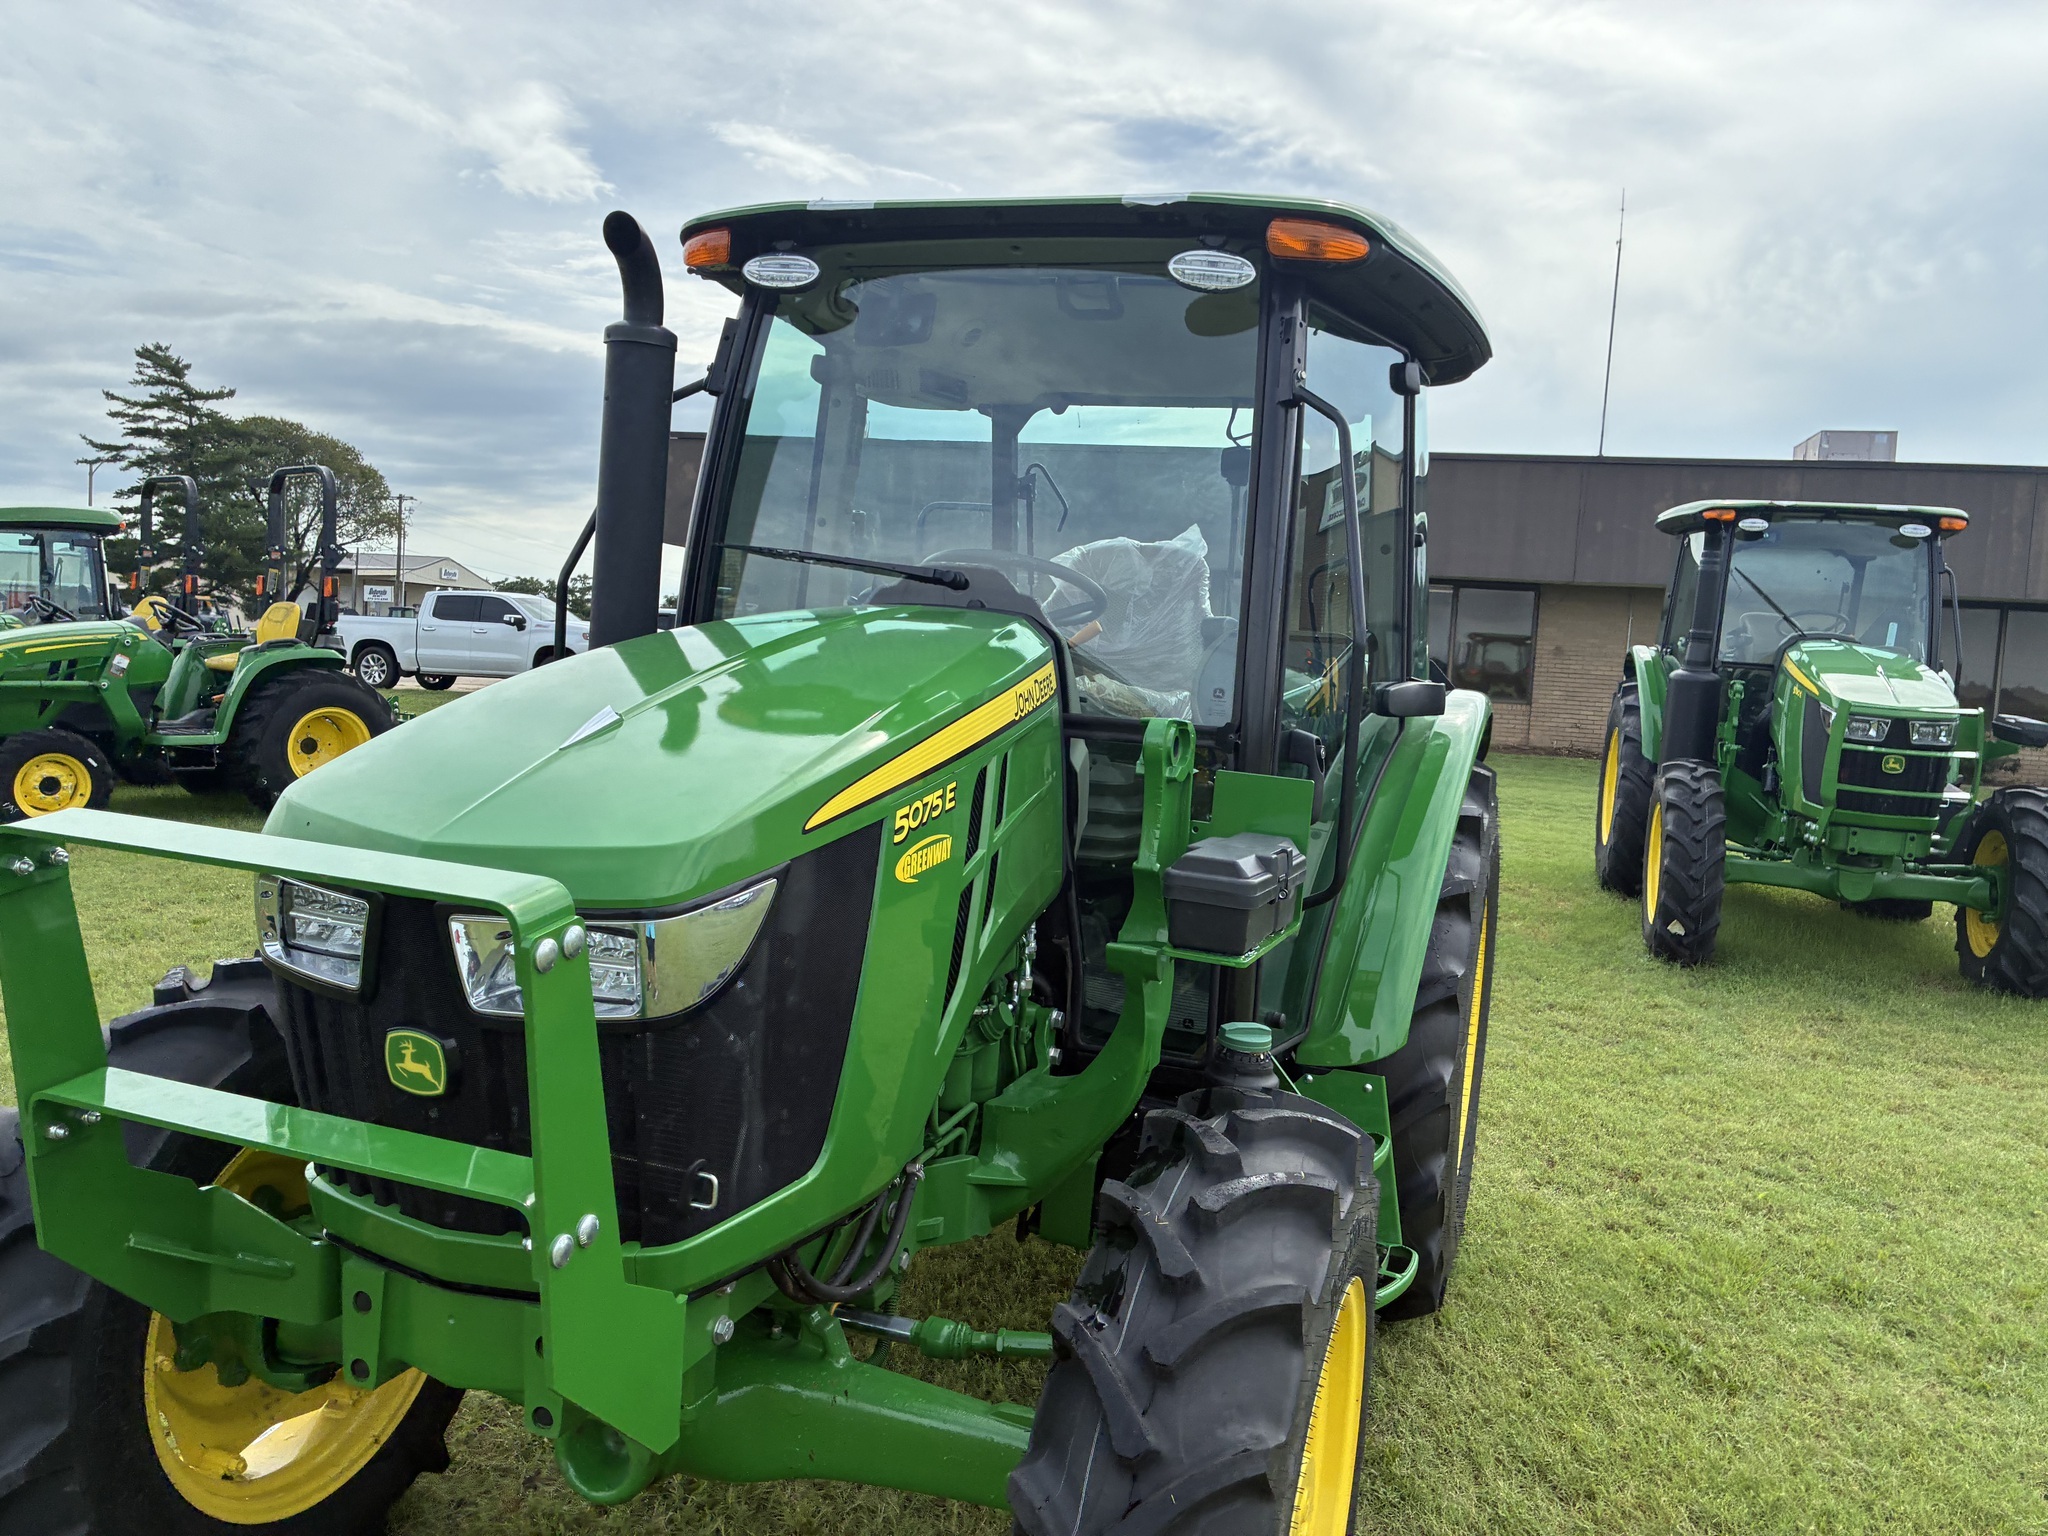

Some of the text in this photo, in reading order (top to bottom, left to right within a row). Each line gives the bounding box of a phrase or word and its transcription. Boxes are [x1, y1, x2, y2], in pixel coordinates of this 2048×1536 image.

[1014, 672, 1054, 716] JOHN DEERE
[903, 836, 953, 879] GREENWAY
